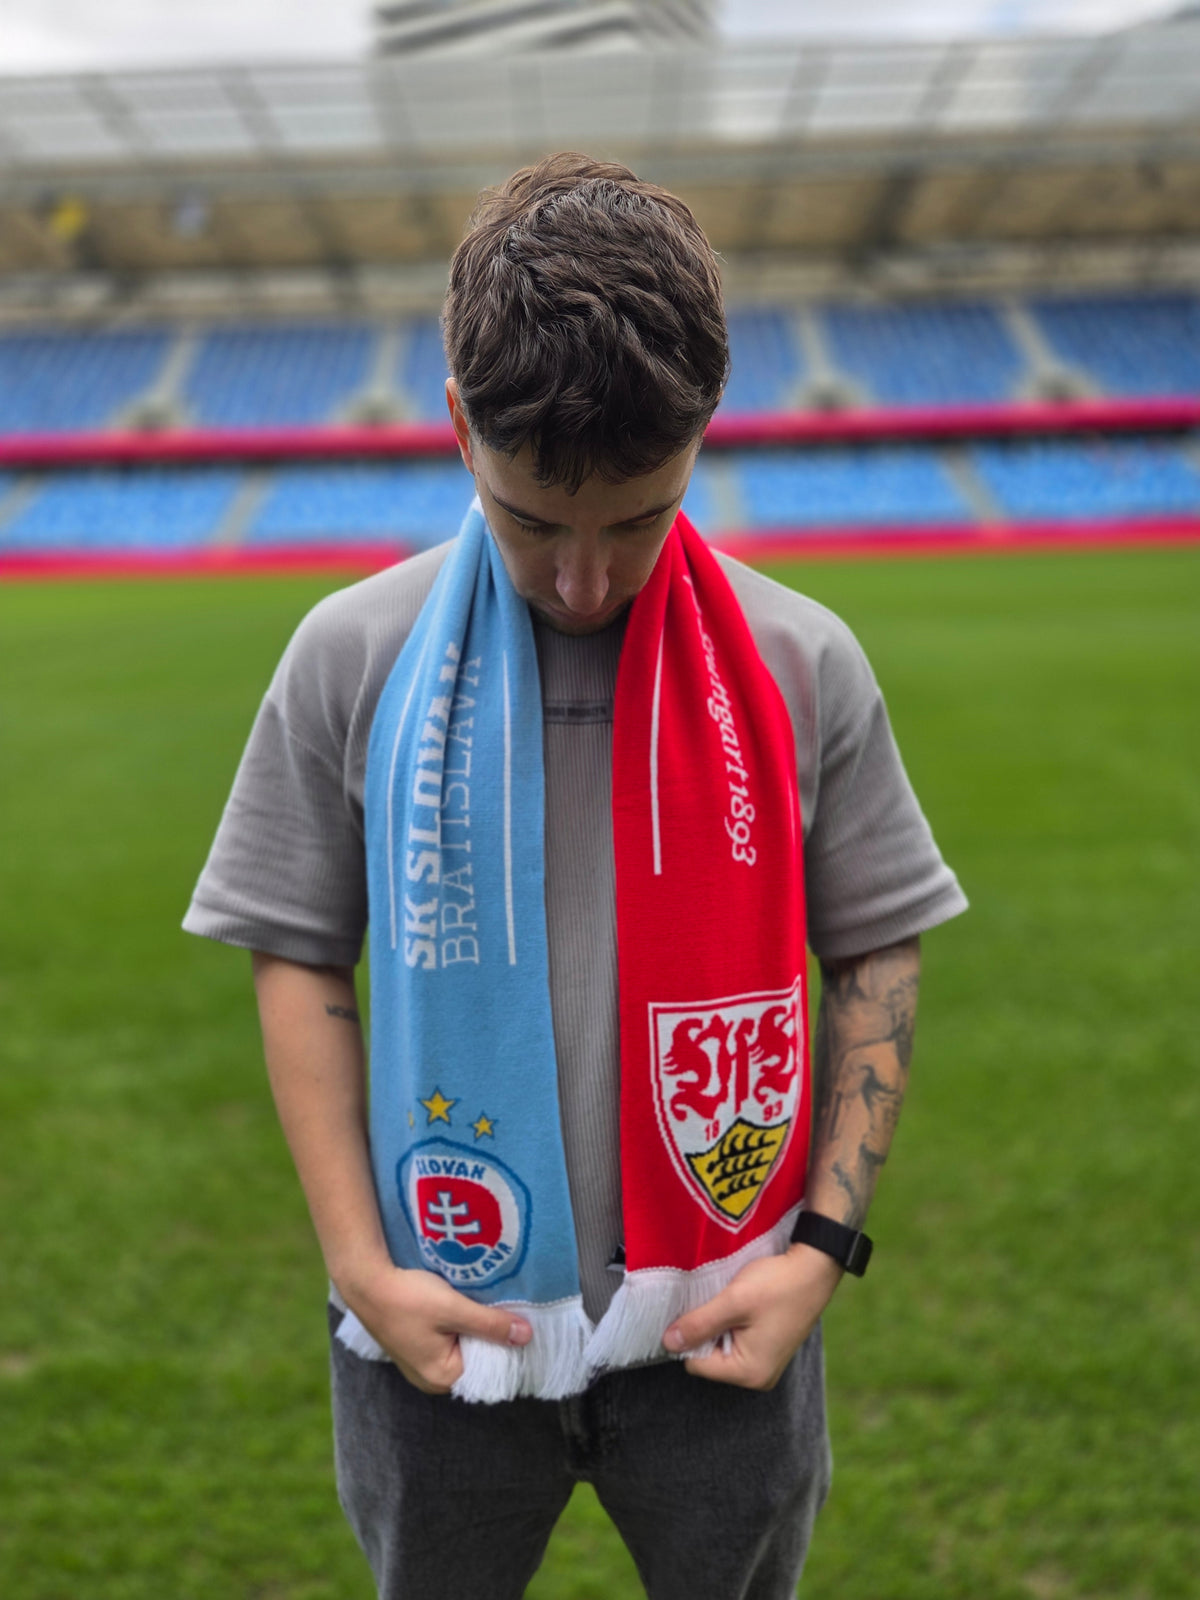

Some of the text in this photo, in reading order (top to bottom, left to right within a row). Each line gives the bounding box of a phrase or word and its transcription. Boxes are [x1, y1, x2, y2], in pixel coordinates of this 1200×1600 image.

[724, 782, 757, 866] 1893
[403, 893, 439, 969] SK
[704, 1119, 720, 1142] 18
